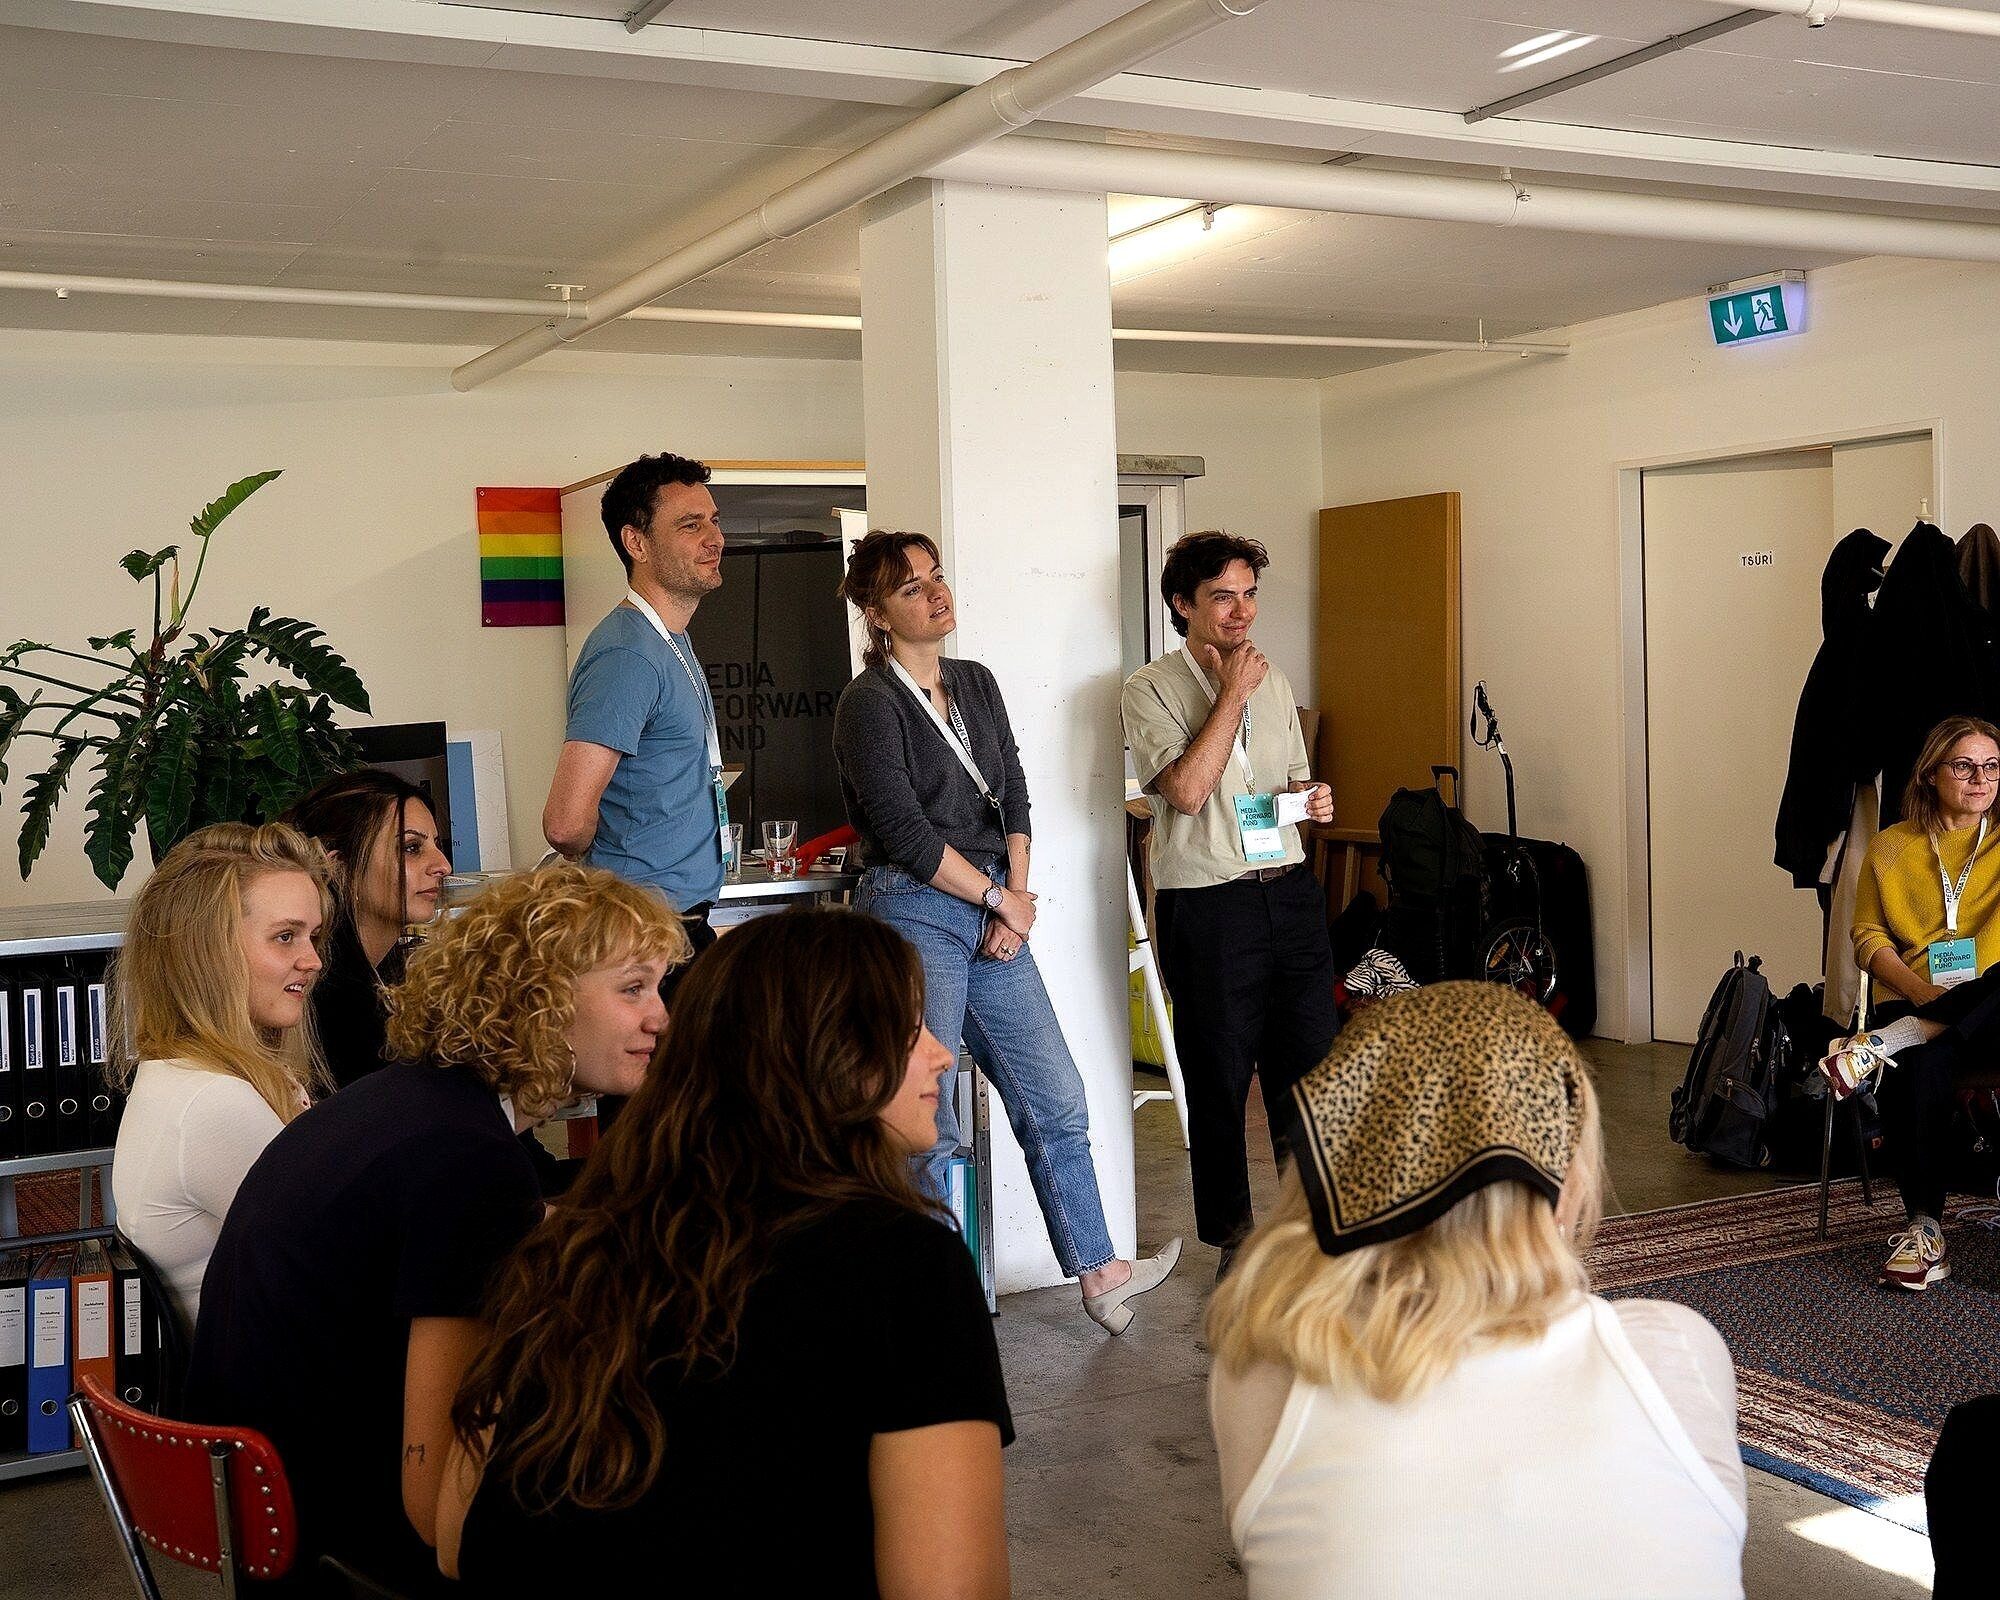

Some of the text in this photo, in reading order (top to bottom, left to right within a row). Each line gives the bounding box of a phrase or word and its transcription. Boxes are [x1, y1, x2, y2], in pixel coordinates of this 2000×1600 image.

[705, 660, 775, 689] EDIA
[711, 690, 841, 721] FORWAR
[716, 725, 766, 750] ND
[1240, 807, 1258, 815] MEDIA
[1245, 812, 1272, 820] FORWARD
[1934, 951, 1955, 959] MEDIA
[1939, 953, 1971, 964] FORWARD
[1934, 961, 1953, 970] FUND
